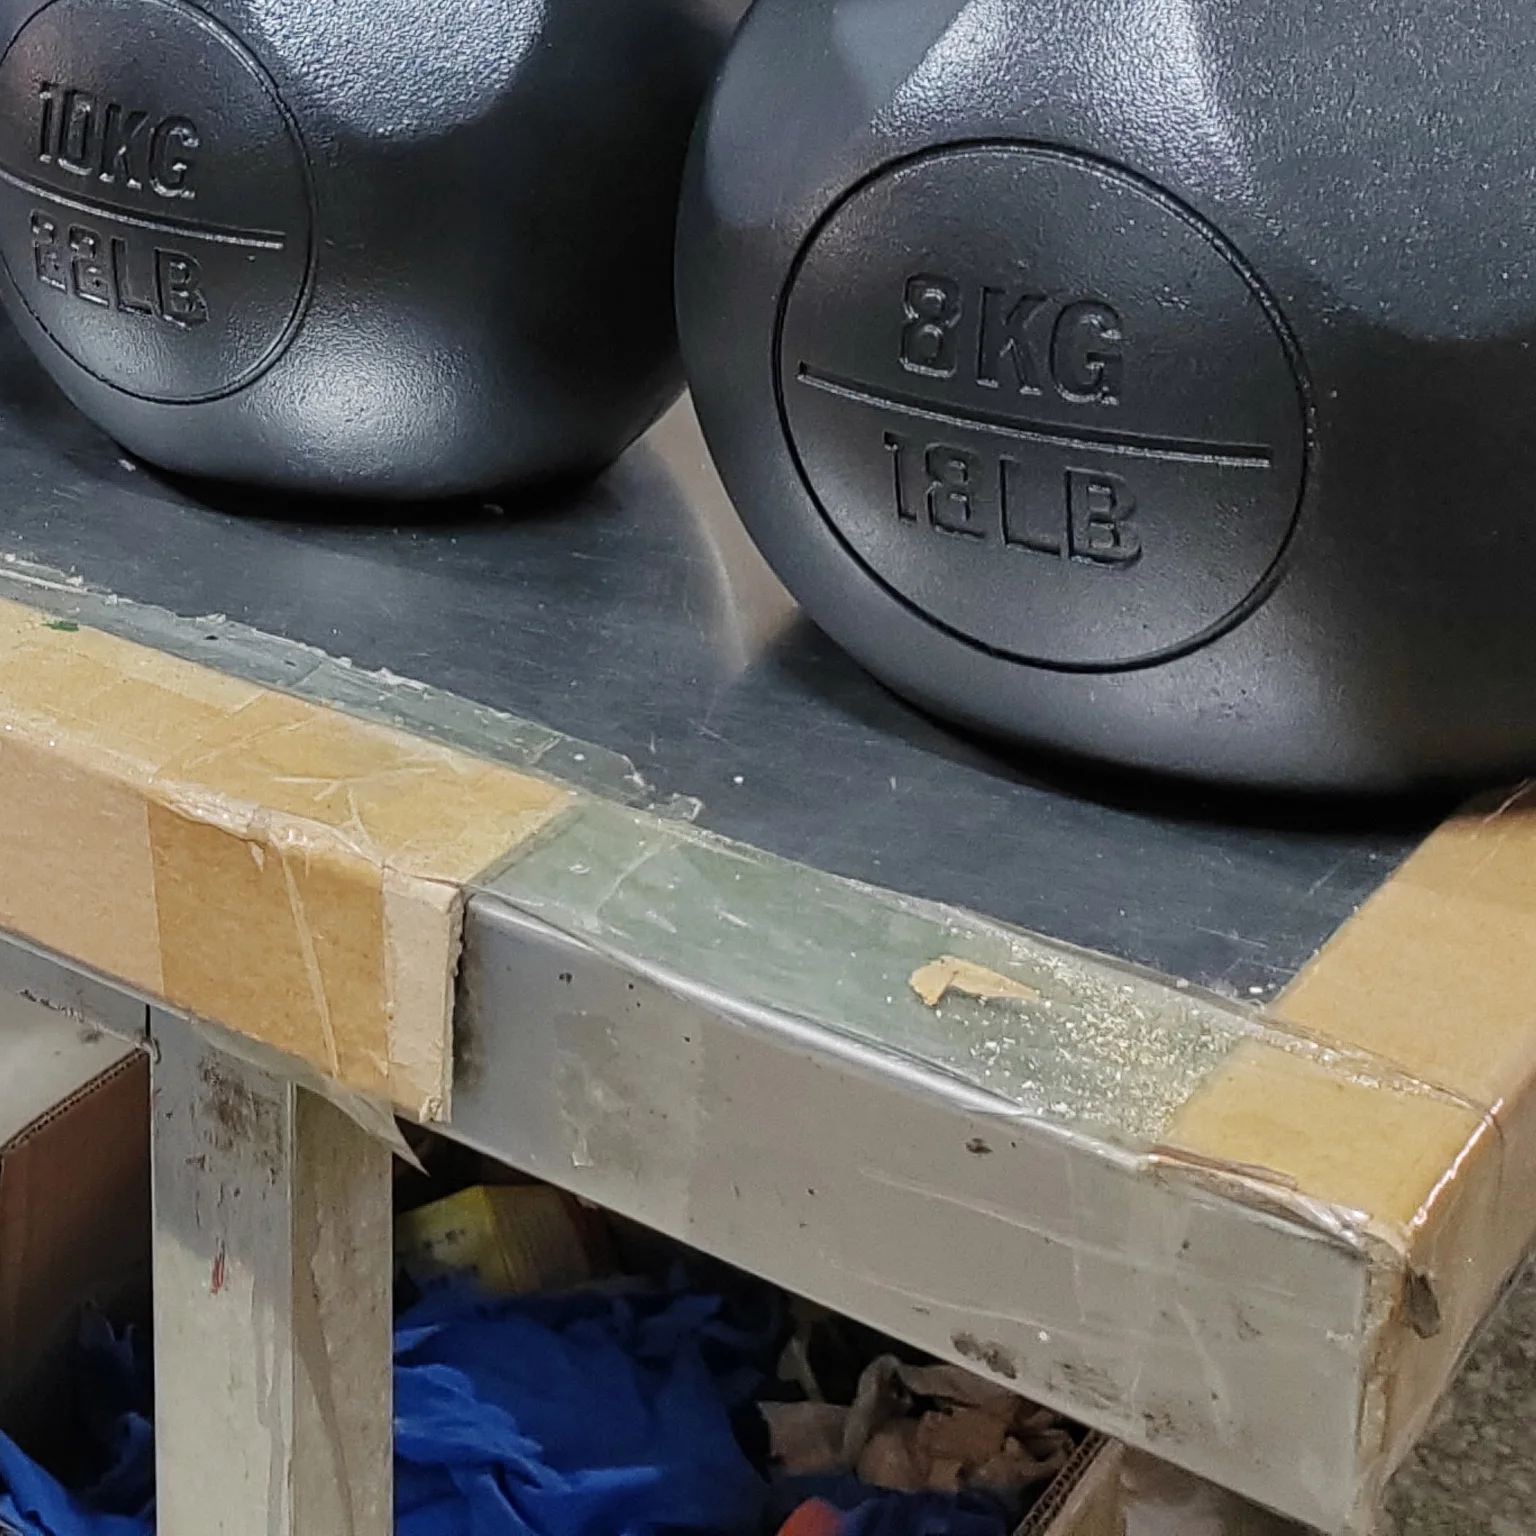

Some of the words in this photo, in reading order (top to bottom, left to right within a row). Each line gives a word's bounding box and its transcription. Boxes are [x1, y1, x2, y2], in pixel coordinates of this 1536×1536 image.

[38, 81, 200, 200] 10KG
[30, 209, 211, 332] 22LB
[899, 272, 1124, 407] 8KG
[882, 431, 1144, 570] 18LB
